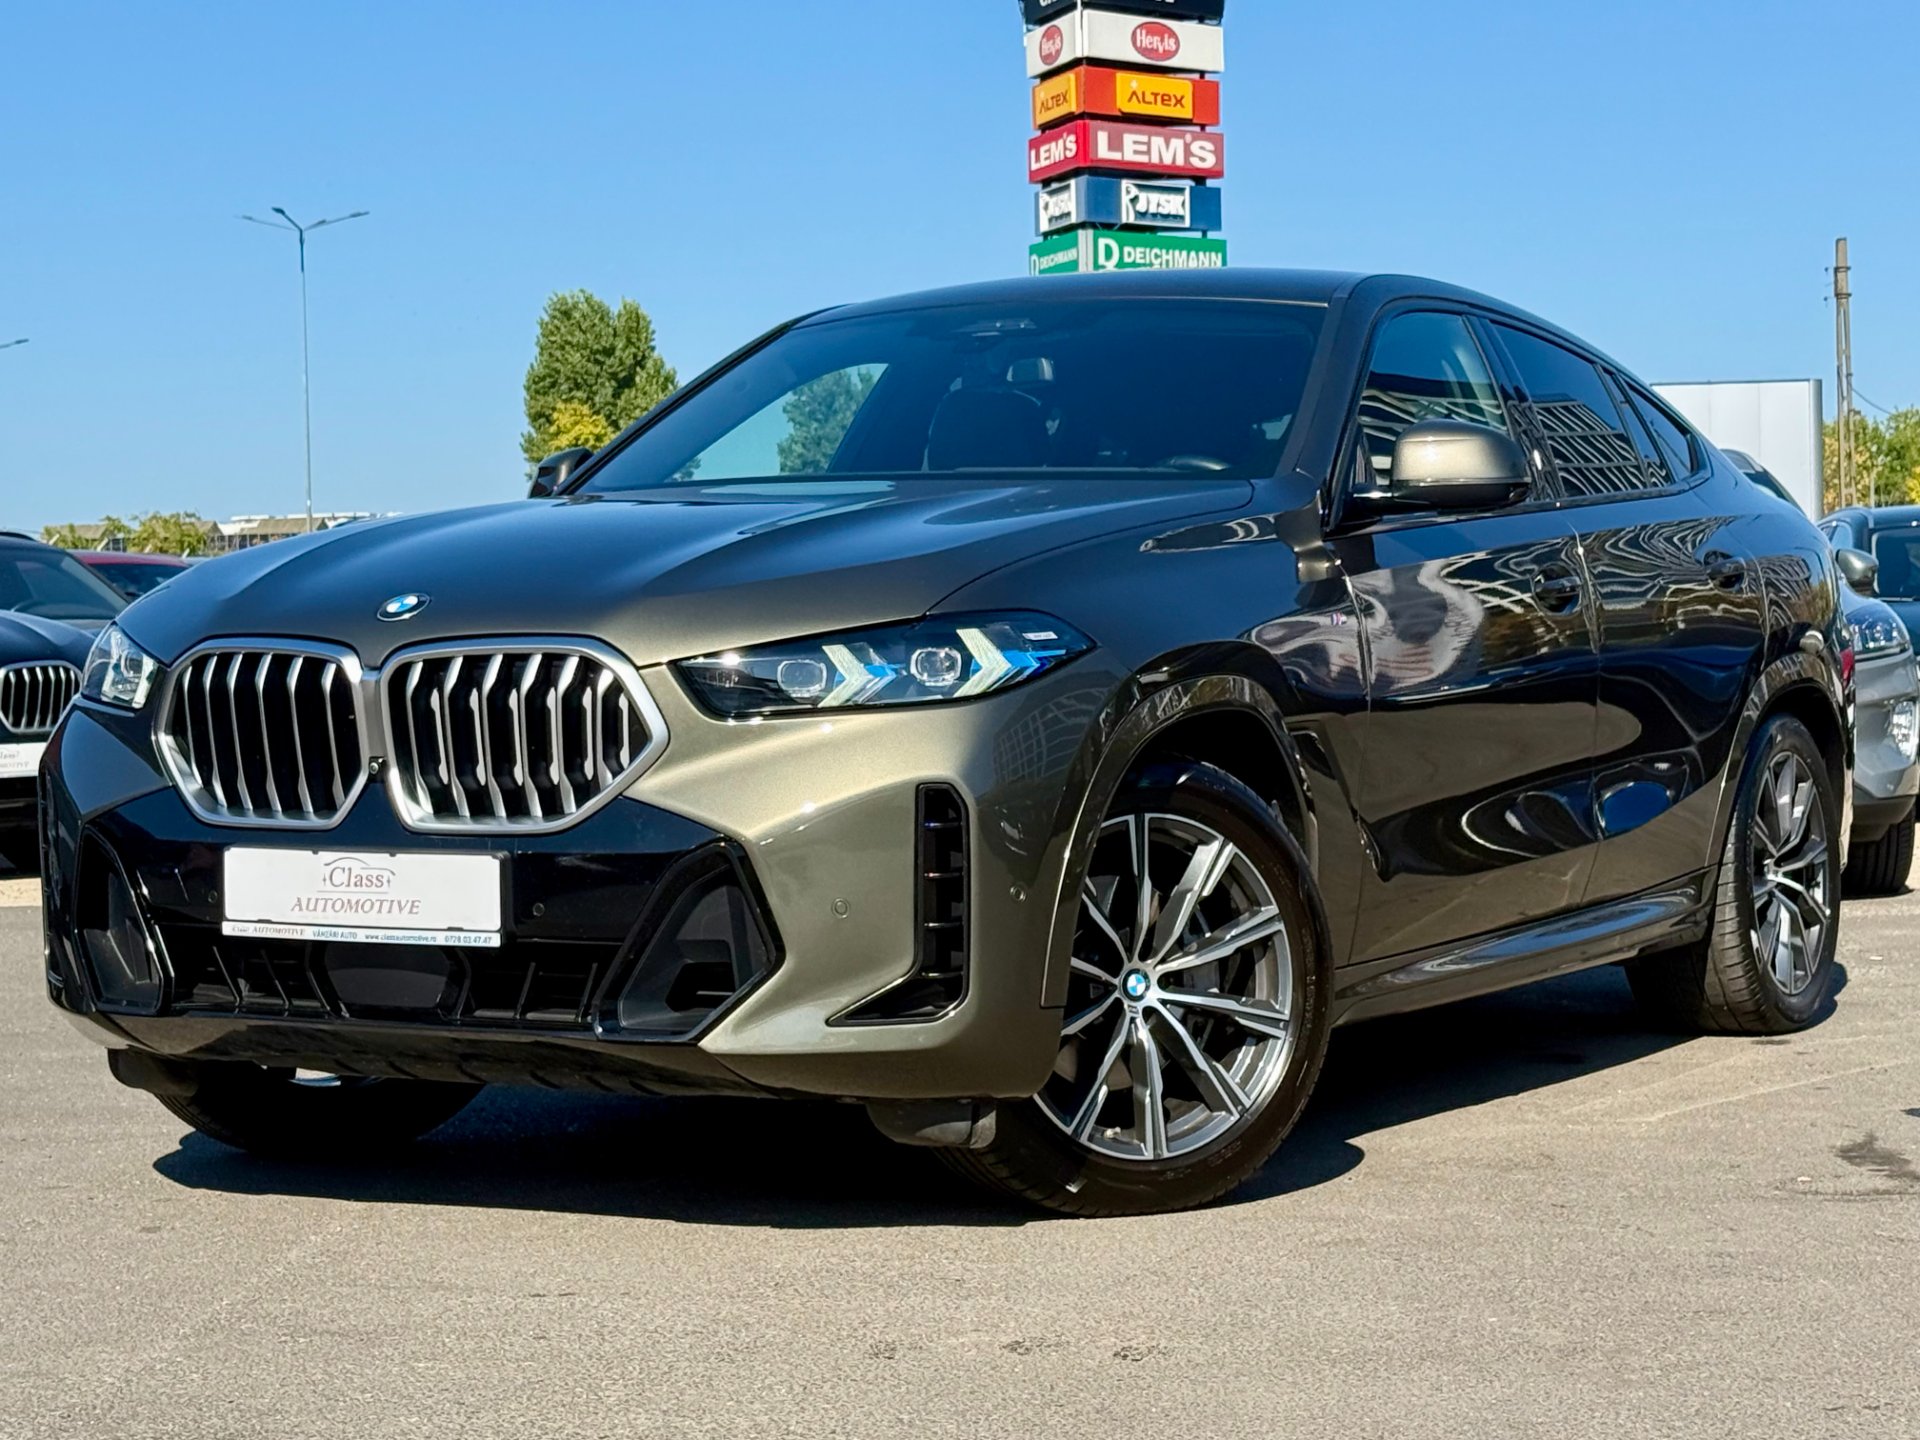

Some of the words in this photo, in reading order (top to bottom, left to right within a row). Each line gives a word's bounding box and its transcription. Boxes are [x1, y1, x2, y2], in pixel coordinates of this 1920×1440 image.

[1136, 29, 1177, 53] Hervis
[1030, 133, 1077, 171] LEM'S
[1097, 131, 1217, 169] LEM'S
[1123, 246, 1222, 268] DEICHMANN
[329, 866, 385, 888] Class
[290, 897, 422, 915] AUTOMOTIVE
[252, 924, 305, 935] AUTOMOTIVE
[340, 931, 358, 940] AUTO
